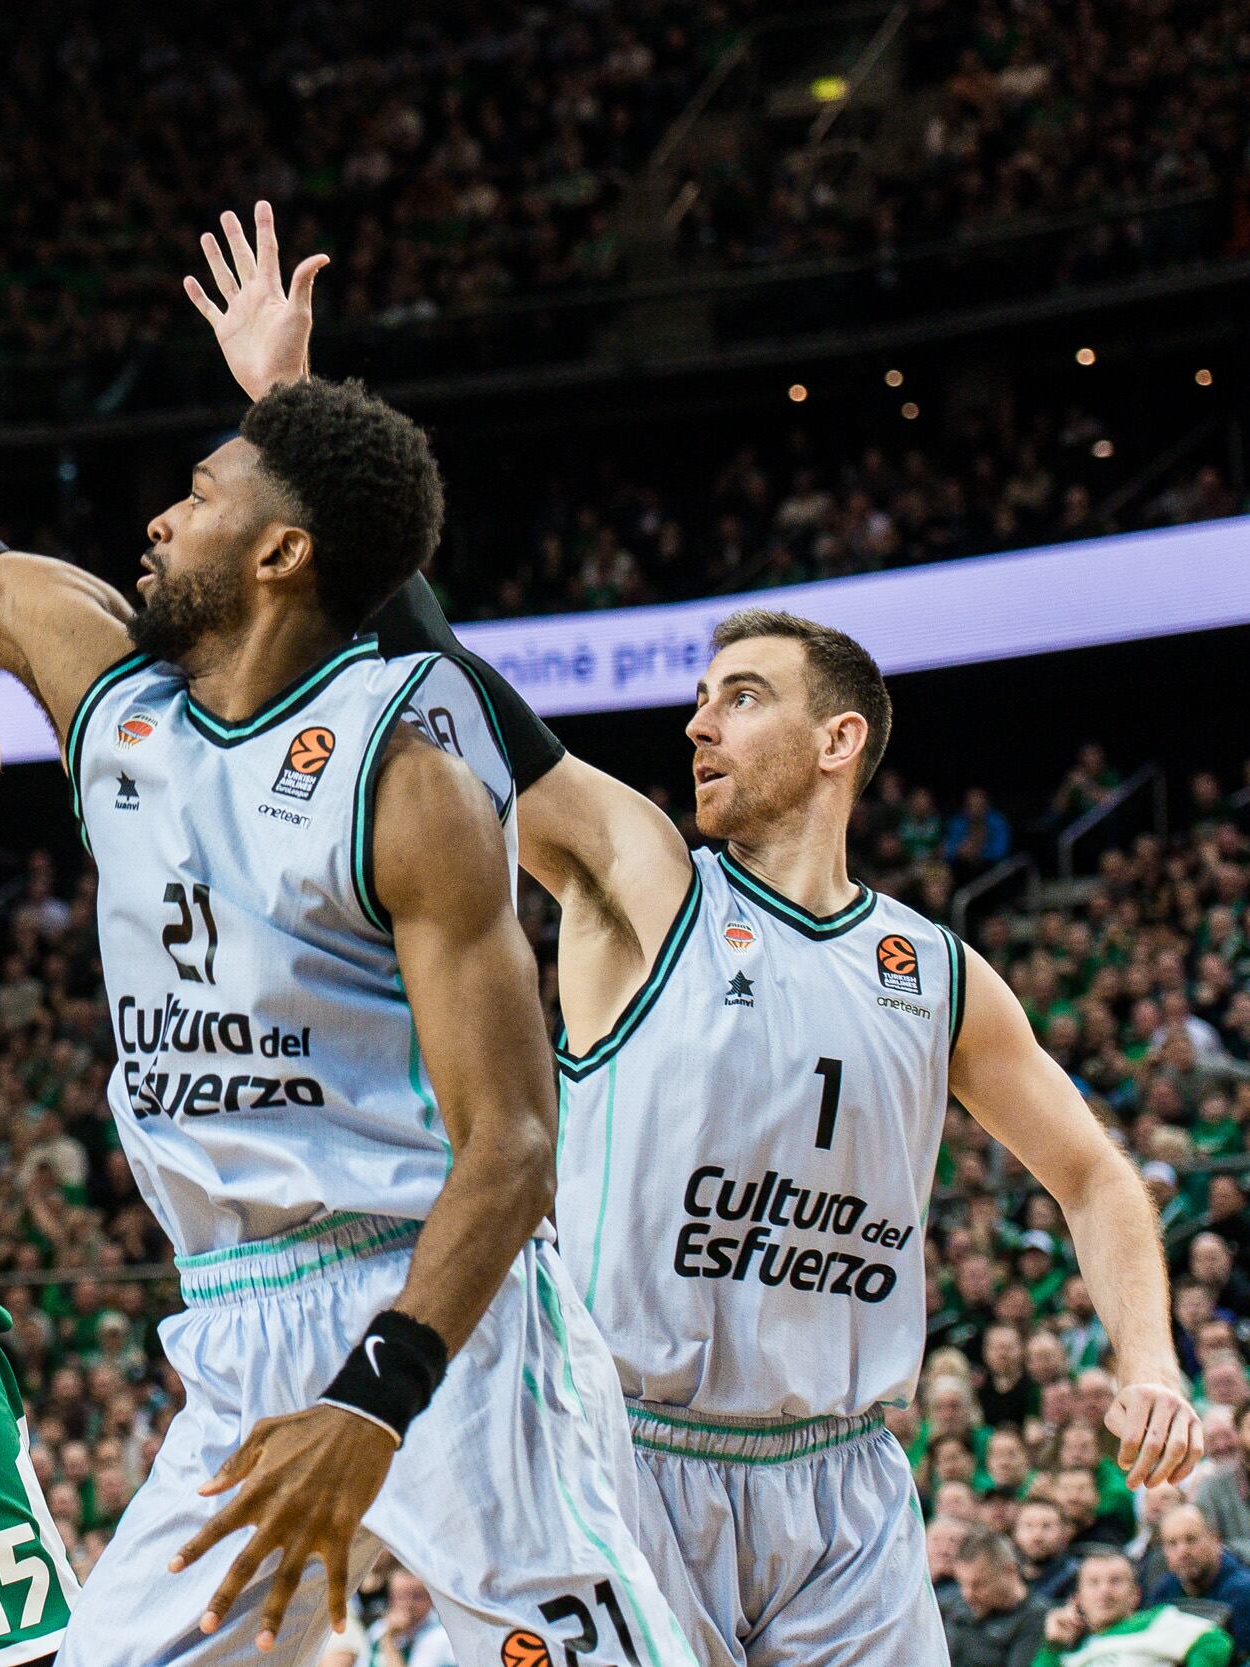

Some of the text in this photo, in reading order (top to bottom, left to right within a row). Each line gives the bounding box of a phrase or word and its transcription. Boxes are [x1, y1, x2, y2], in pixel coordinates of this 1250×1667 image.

[115, 800, 139, 811] luanvi
[258, 804, 312, 829] oneteam
[162, 883, 218, 985] 21
[118, 993, 311, 1058] Cultura del
[877, 996, 931, 1020] oneteam
[814, 1057, 843, 1151] 1
[683, 1165, 914, 1251] Cultura del
[673, 1223, 897, 1304] Esfuerzo
[538, 1578, 642, 1667] 21
